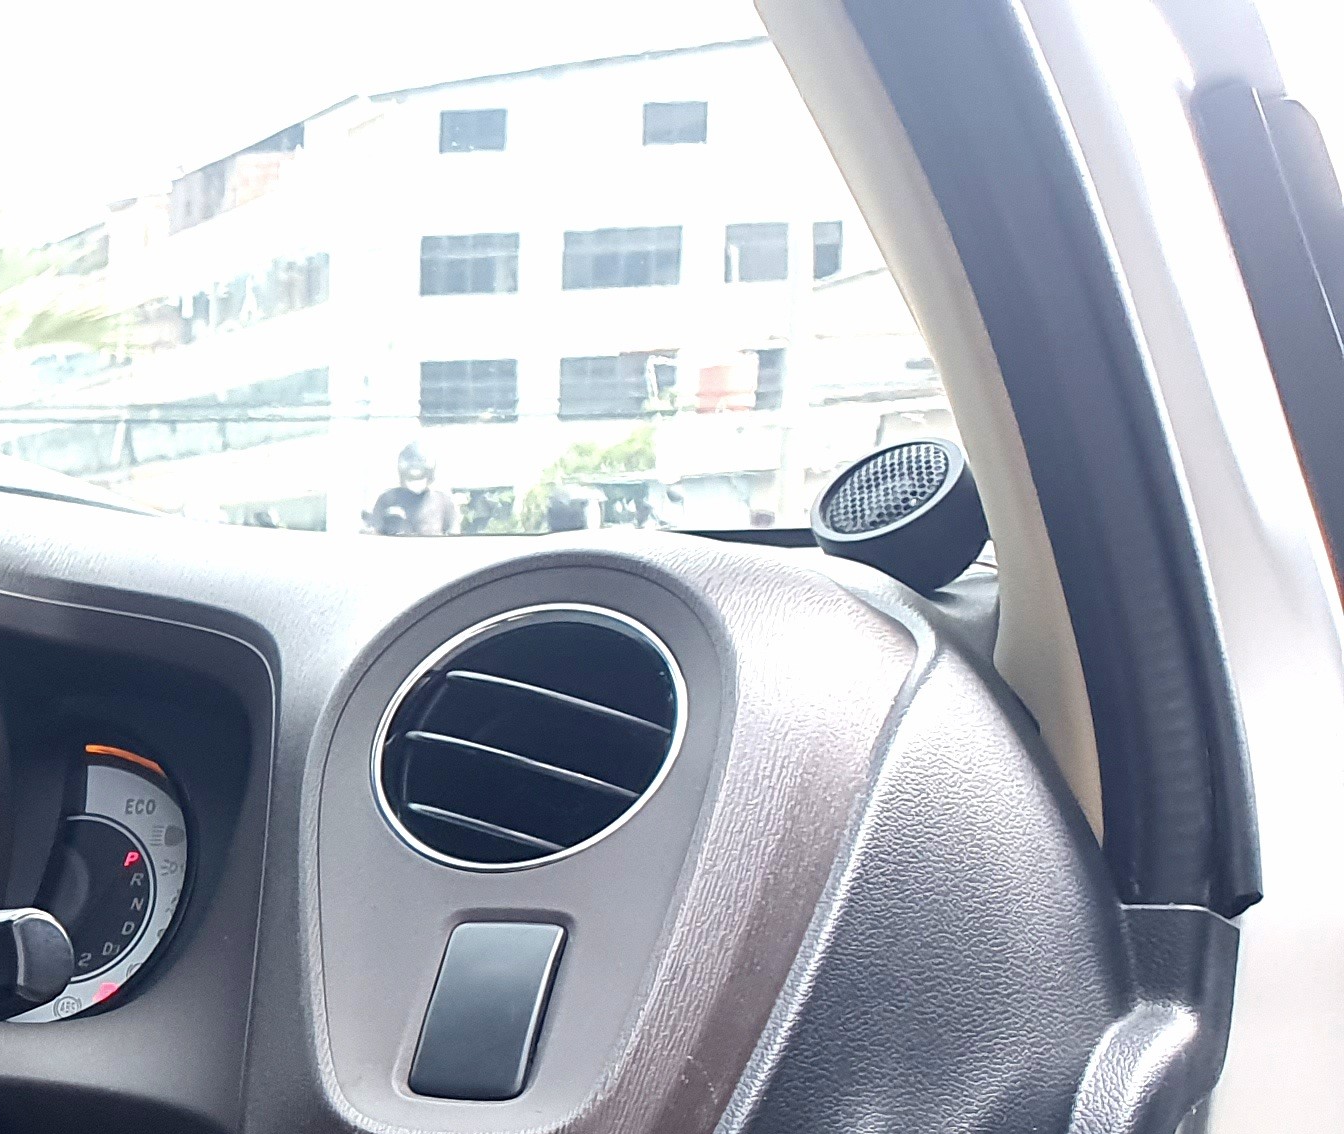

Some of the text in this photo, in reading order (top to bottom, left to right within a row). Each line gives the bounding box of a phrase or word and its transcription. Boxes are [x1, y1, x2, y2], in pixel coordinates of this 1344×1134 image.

[125, 799, 156, 815] ECO
[123, 851, 140, 867] P
[130, 873, 144, 886] R
[131, 897, 144, 911] N
[121, 921, 135, 935] D
[77, 953, 92, 968] 2
